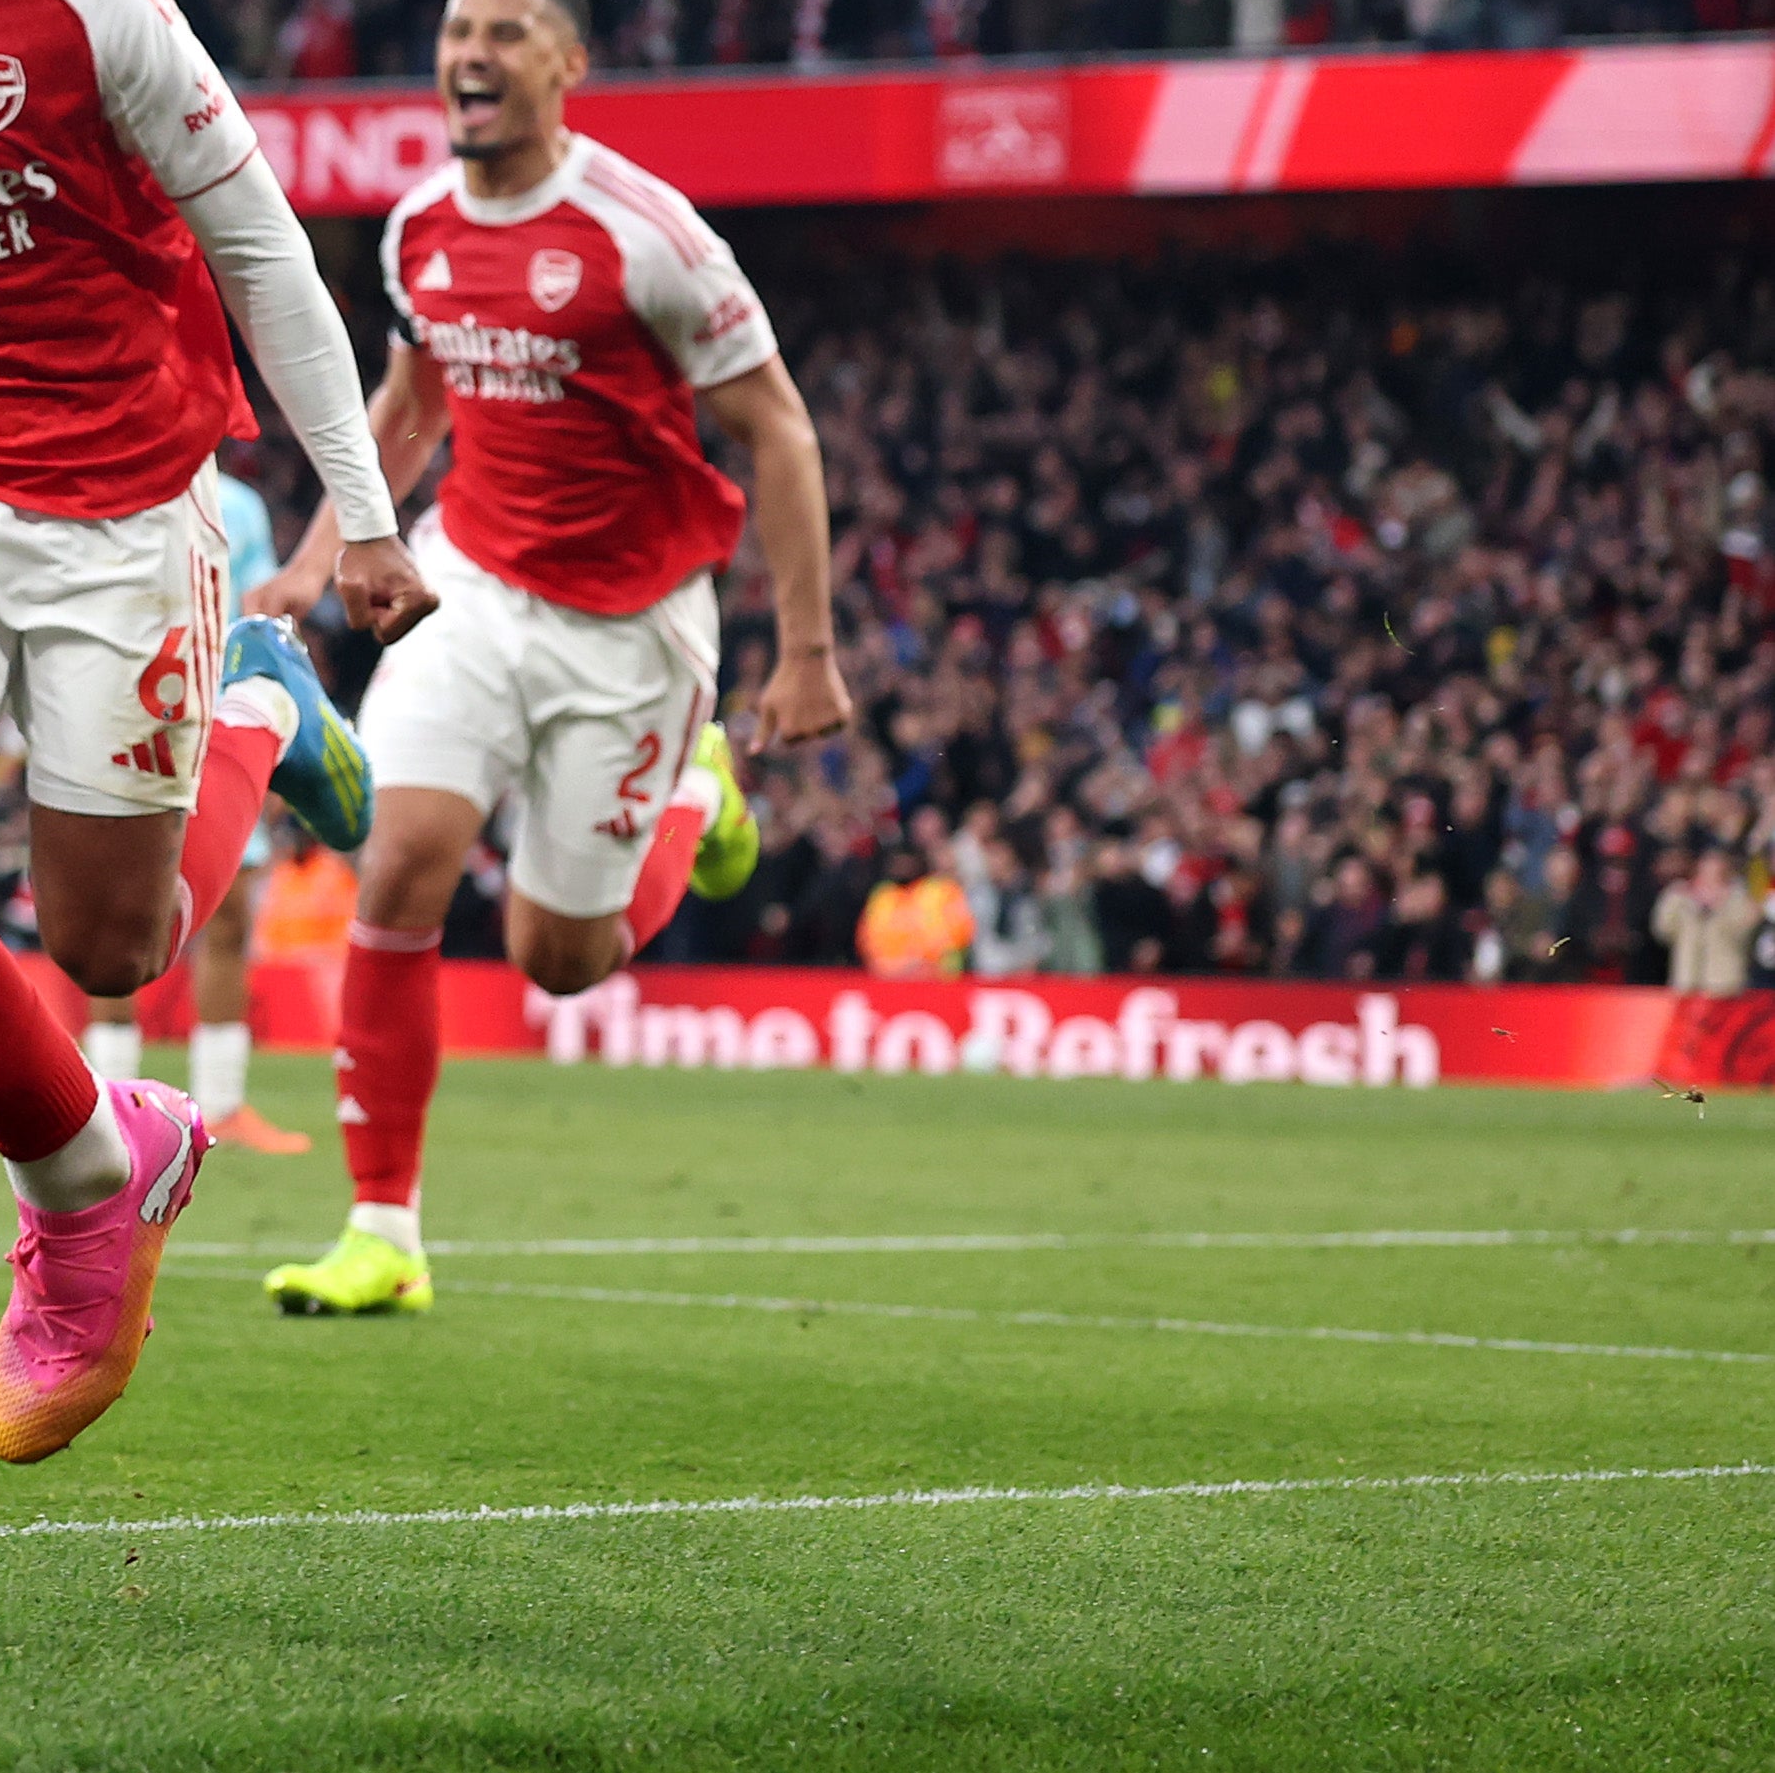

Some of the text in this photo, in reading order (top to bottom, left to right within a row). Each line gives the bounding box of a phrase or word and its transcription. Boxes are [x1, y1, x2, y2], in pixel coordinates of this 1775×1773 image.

[303, 105, 451, 202] NO
[138, 625, 190, 723] 6
[617, 730, 663, 803] 2
[523, 970, 1443, 1091] Time to Refresh
